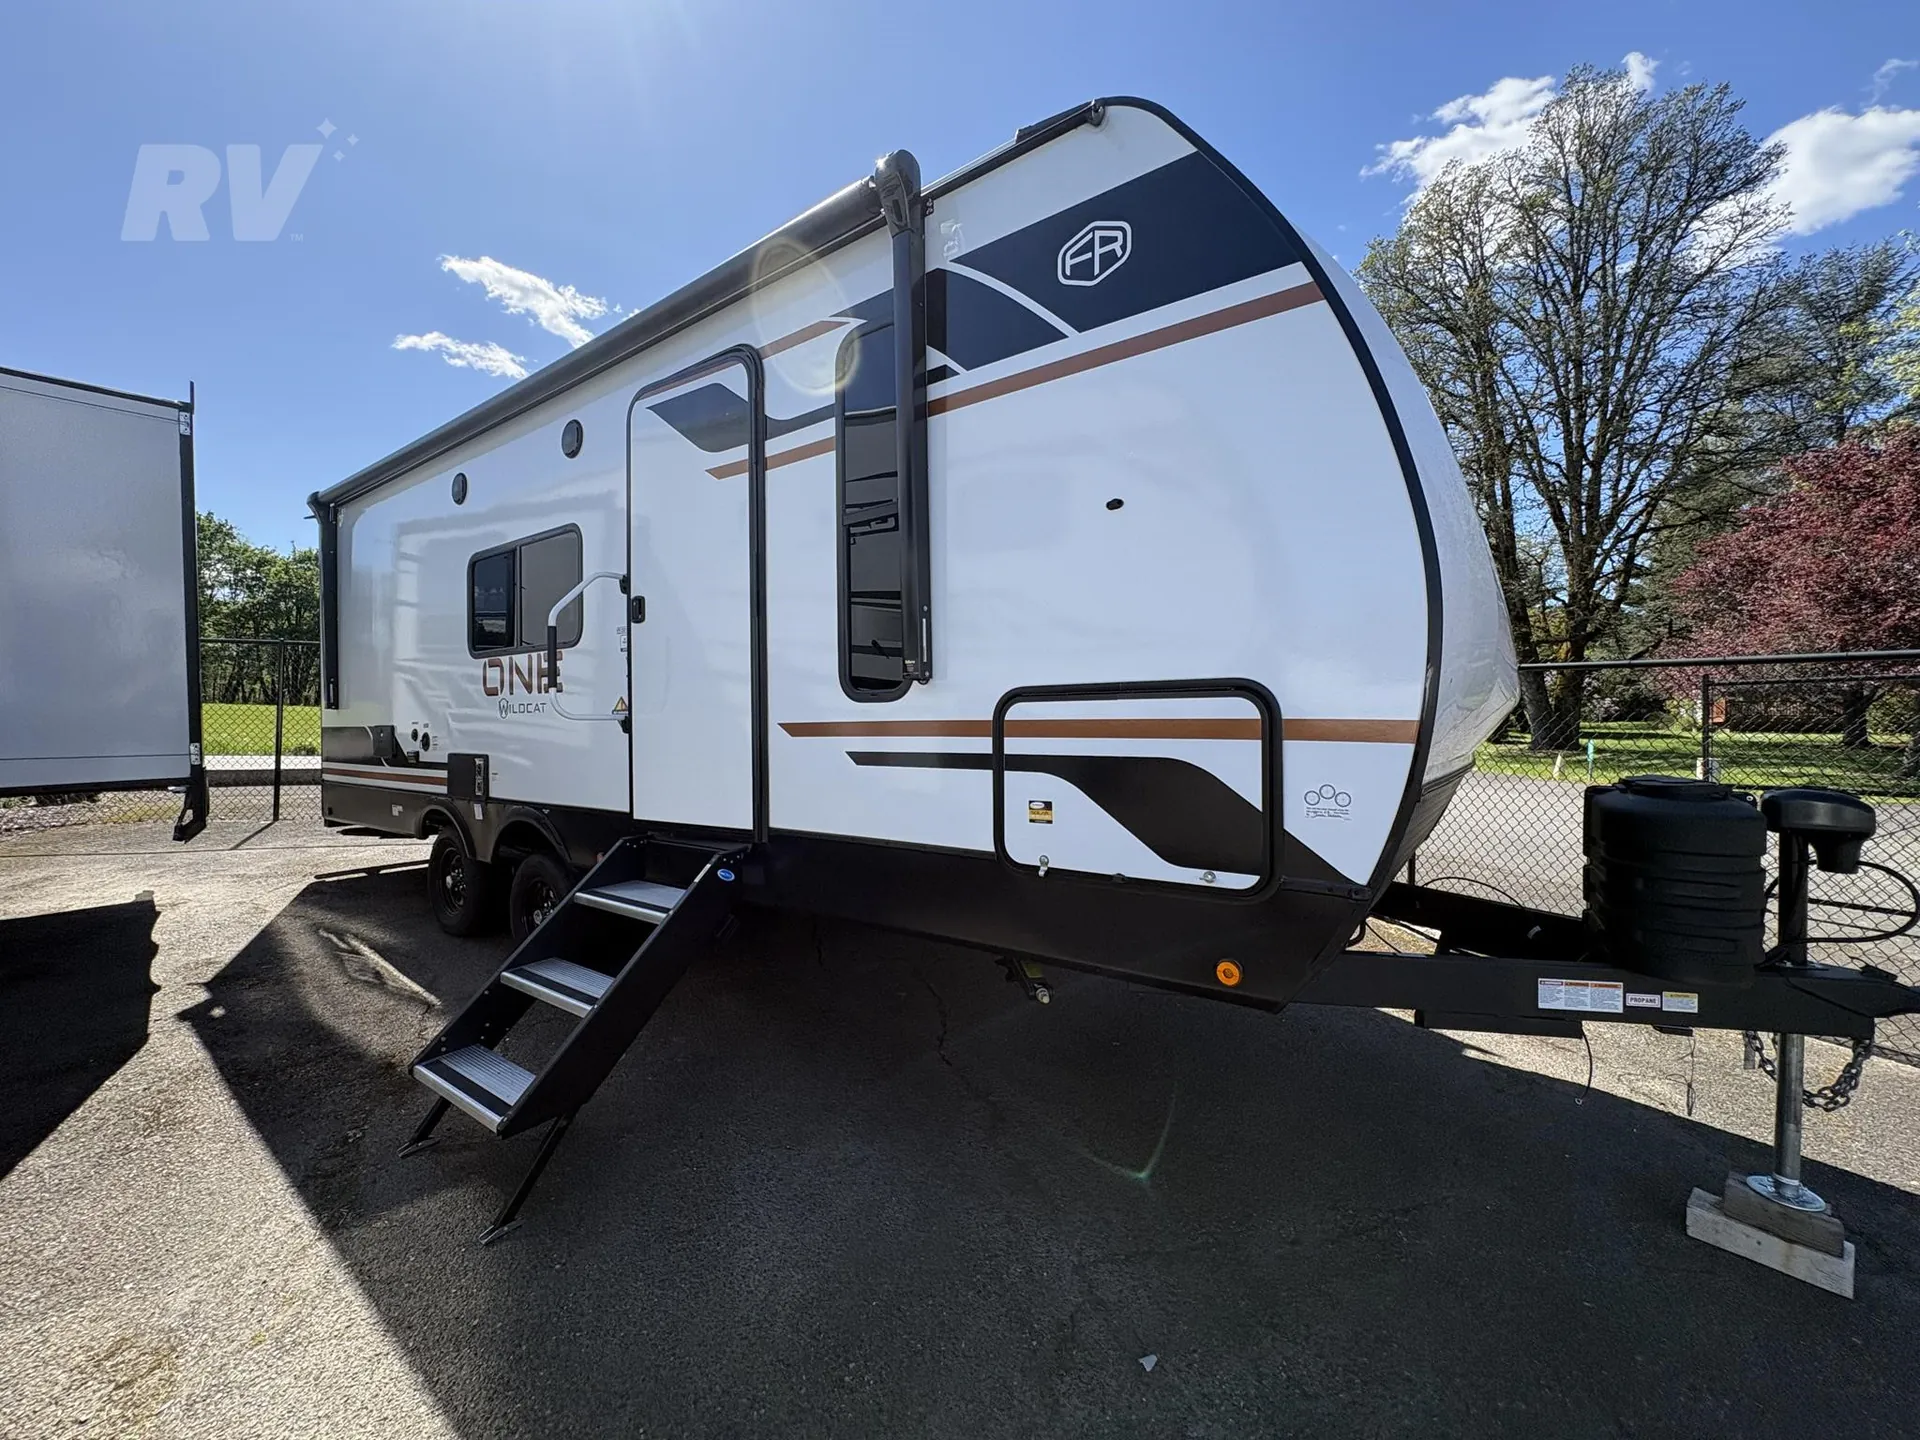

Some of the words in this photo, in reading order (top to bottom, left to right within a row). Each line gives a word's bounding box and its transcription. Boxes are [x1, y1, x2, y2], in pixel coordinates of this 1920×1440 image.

[1064, 229, 1124, 277] FR
[482, 650, 564, 697] ONE
[498, 697, 547, 719] WILDCAT
